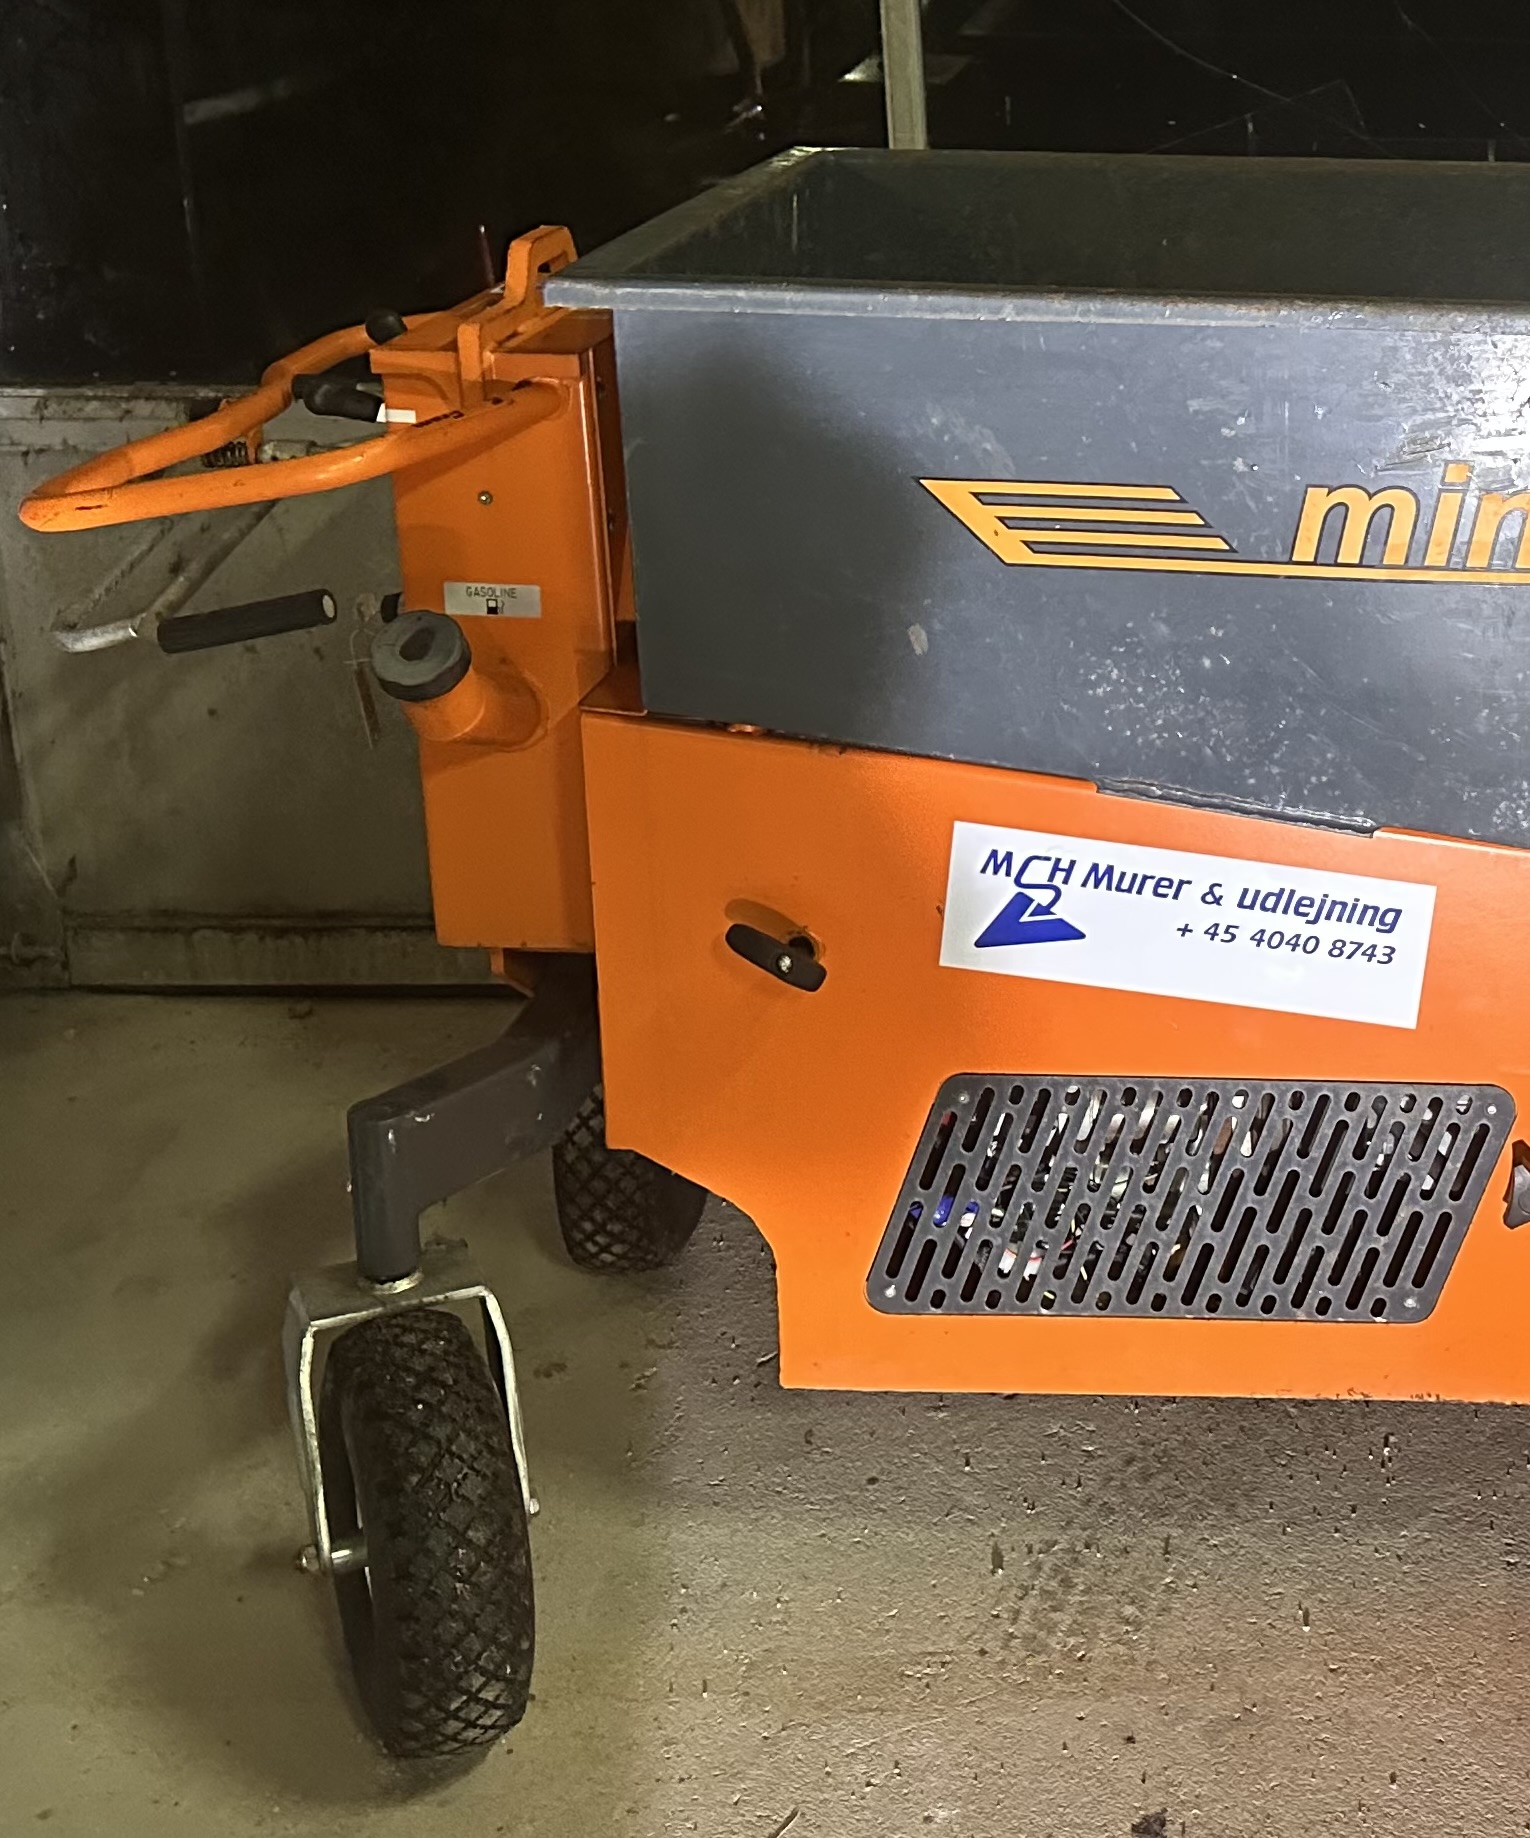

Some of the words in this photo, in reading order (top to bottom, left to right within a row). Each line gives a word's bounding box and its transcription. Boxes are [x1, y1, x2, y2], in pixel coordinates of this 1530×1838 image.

[466, 586, 517, 599] GASOLINE
[980, 849, 1076, 888] MCH
[1081, 862, 1192, 900] Murer
[1201, 883, 1224, 906] &
[1237, 886, 1402, 934] udlejning
[1177, 922, 1194, 938] +
[1204, 922, 1237, 944] 45
[1250, 928, 1319, 955] 4040
[1328, 939, 1397, 966] 8743
